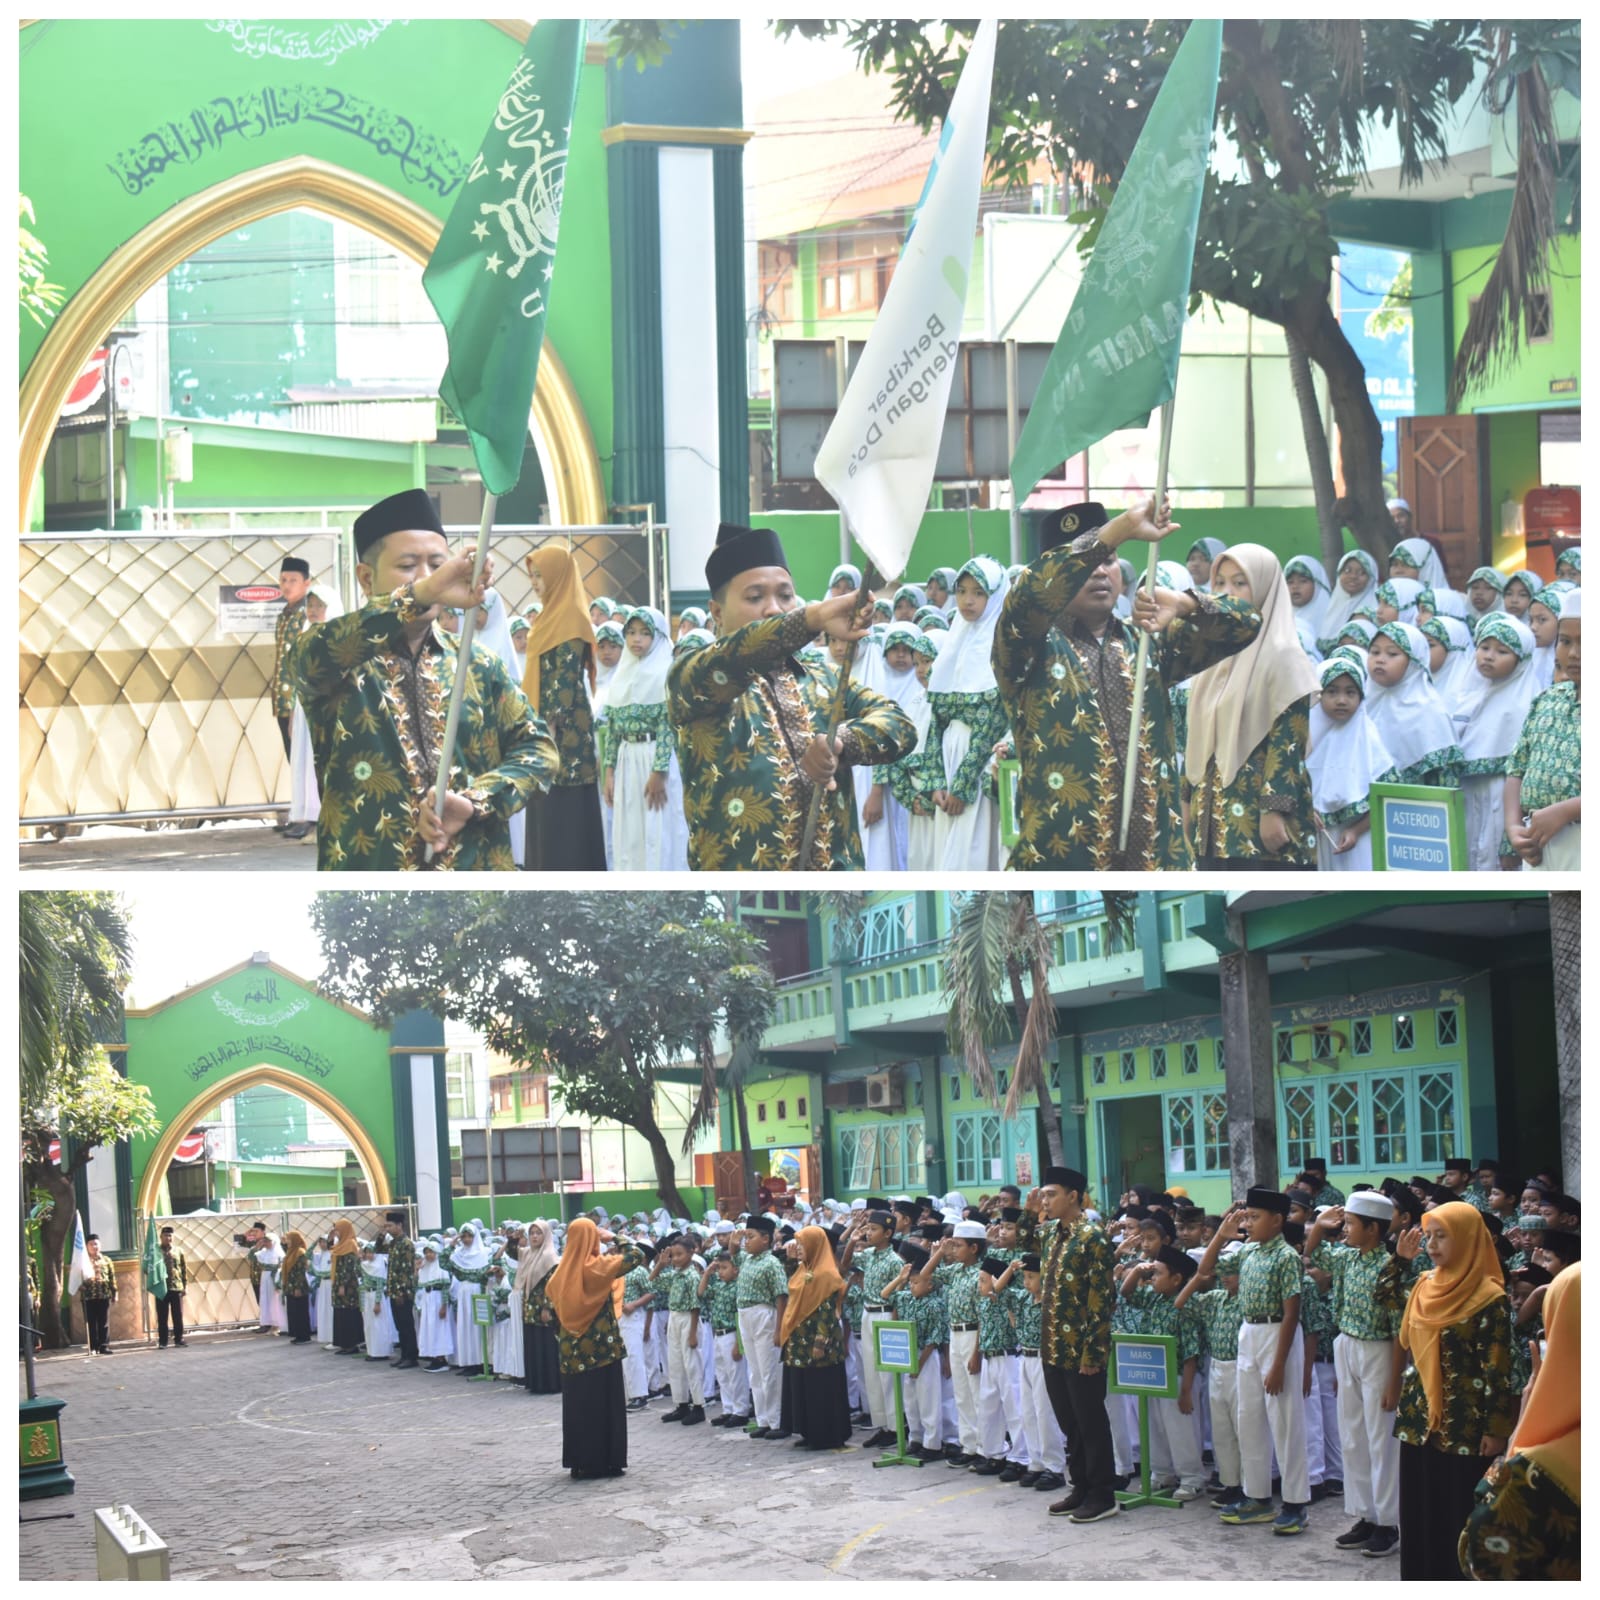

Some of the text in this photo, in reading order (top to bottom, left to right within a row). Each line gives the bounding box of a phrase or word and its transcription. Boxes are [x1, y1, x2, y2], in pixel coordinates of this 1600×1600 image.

[1392, 811, 1440, 829] ASTEROID
[1392, 844, 1444, 863] METEROID
[1129, 1350, 1153, 1360] MARS
[1127, 1370, 1157, 1380] JUPITER
